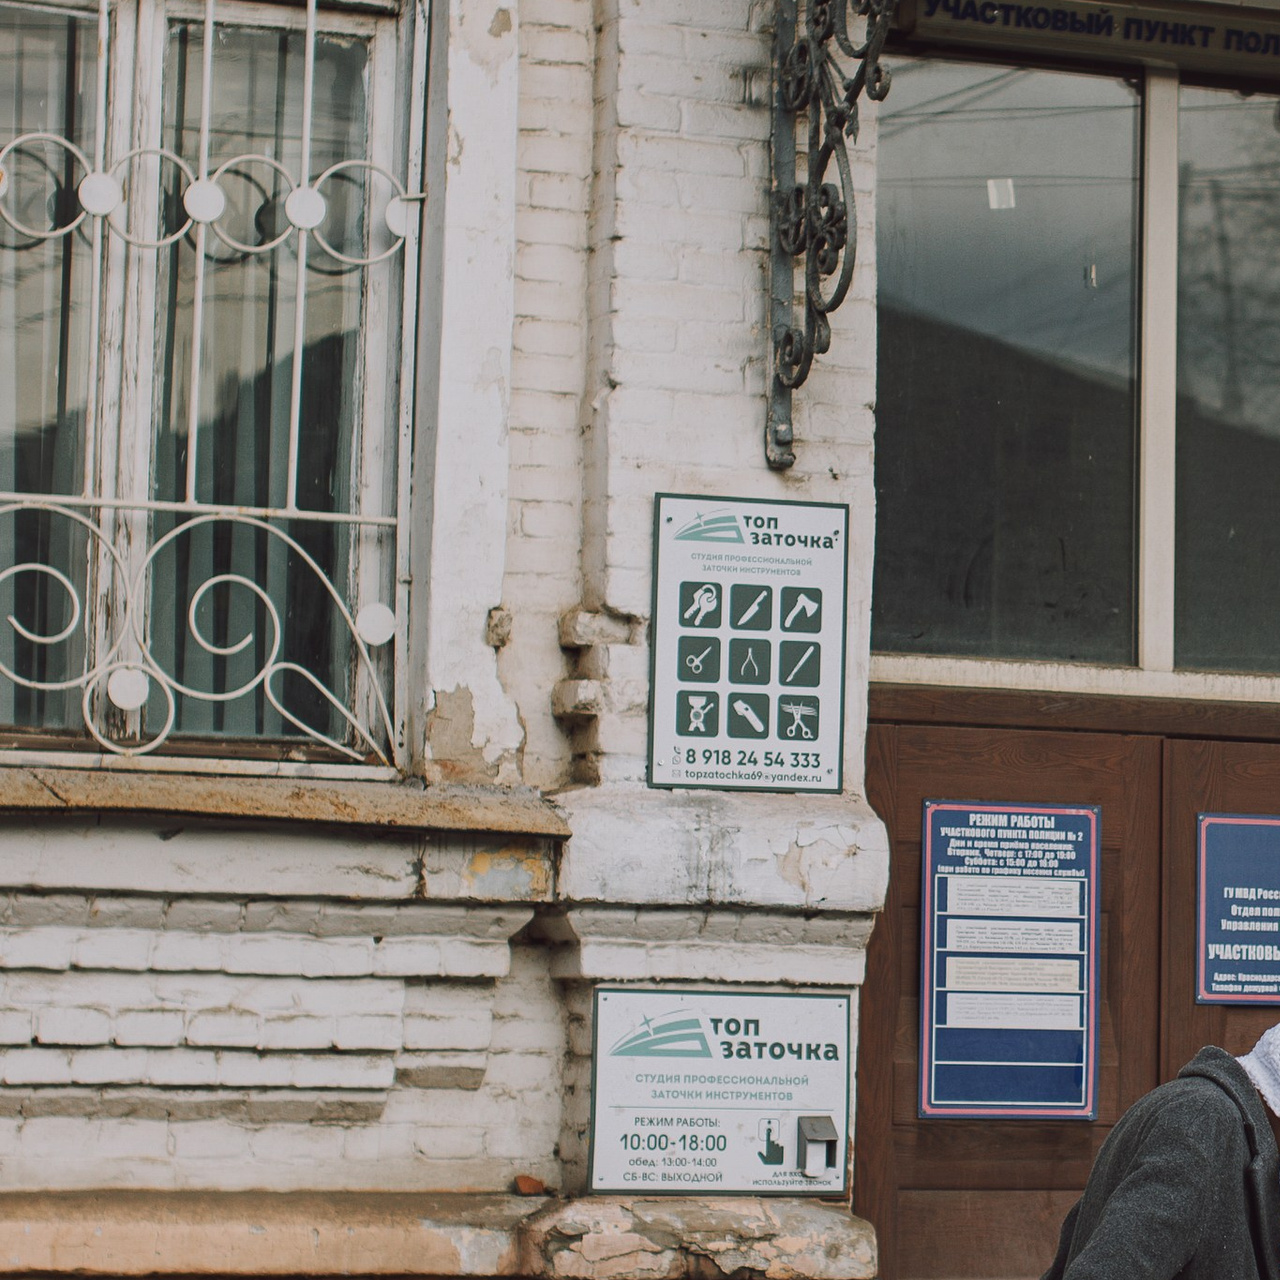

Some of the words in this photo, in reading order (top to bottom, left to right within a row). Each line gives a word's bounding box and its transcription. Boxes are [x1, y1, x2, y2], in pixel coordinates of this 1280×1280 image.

[1123, 18, 1216, 48] ПУНКТ
[691, 553, 723, 561] СТУДИЯ
[725, 555, 812, 566] ПРОФЕССИОНАЛЬНОЙ
[702, 565, 738, 573] ЗАТОЧКИ
[740, 567, 801, 576] ИНСТРУМЕНТОВ
[686, 748, 697, 764] 8
[702, 749, 731, 765] 918
[737, 751, 758, 766] 24
[764, 752, 784, 767] 54
[790, 752, 821, 768] 333
[969, 814, 1008, 827] РЕЖИМ
[1010, 815, 1055, 829] РАБОТЫ
[940, 827, 995, 839] УЧАСТКОВОГО
[997, 829, 1027, 840] ПУНКТА
[1029, 831, 1066, 841] ПОЛИЦИИ
[1078, 832, 1084, 841] 2
[949, 838, 965, 849] Дни
[967, 840, 973, 848] и
[1044, 851, 1055, 859] до
[964, 856, 998, 866] Суббота:
[1027, 859, 1038, 867] до
[1223, 887, 1234, 899] ГУ
[1235, 887, 1256, 901] МВД
[1231, 904, 1261, 918] Отдел
[1221, 918, 1279, 932] Управления
[635, 1074, 681, 1084] СТУДИЯ
[683, 1074, 809, 1086] ПРОФЕССИОНАЛЬНОЙ
[651, 1090, 702, 1100] ЗАТОЧКИ
[705, 1091, 793, 1101] ИНСТРУМЕНТОВ
[634, 1116, 674, 1127] РЕЖИМ
[676, 1117, 721, 1128] РАБОТЫ:
[619, 1133, 727, 1152] 10:00-18:00
[628, 1156, 658, 1167] обед:
[661, 1157, 717, 1168] 13:00-14:00
[623, 1171, 659, 1182] СБ-ВС:
[661, 1171, 723, 1183] ВЫХОДНОЙ
